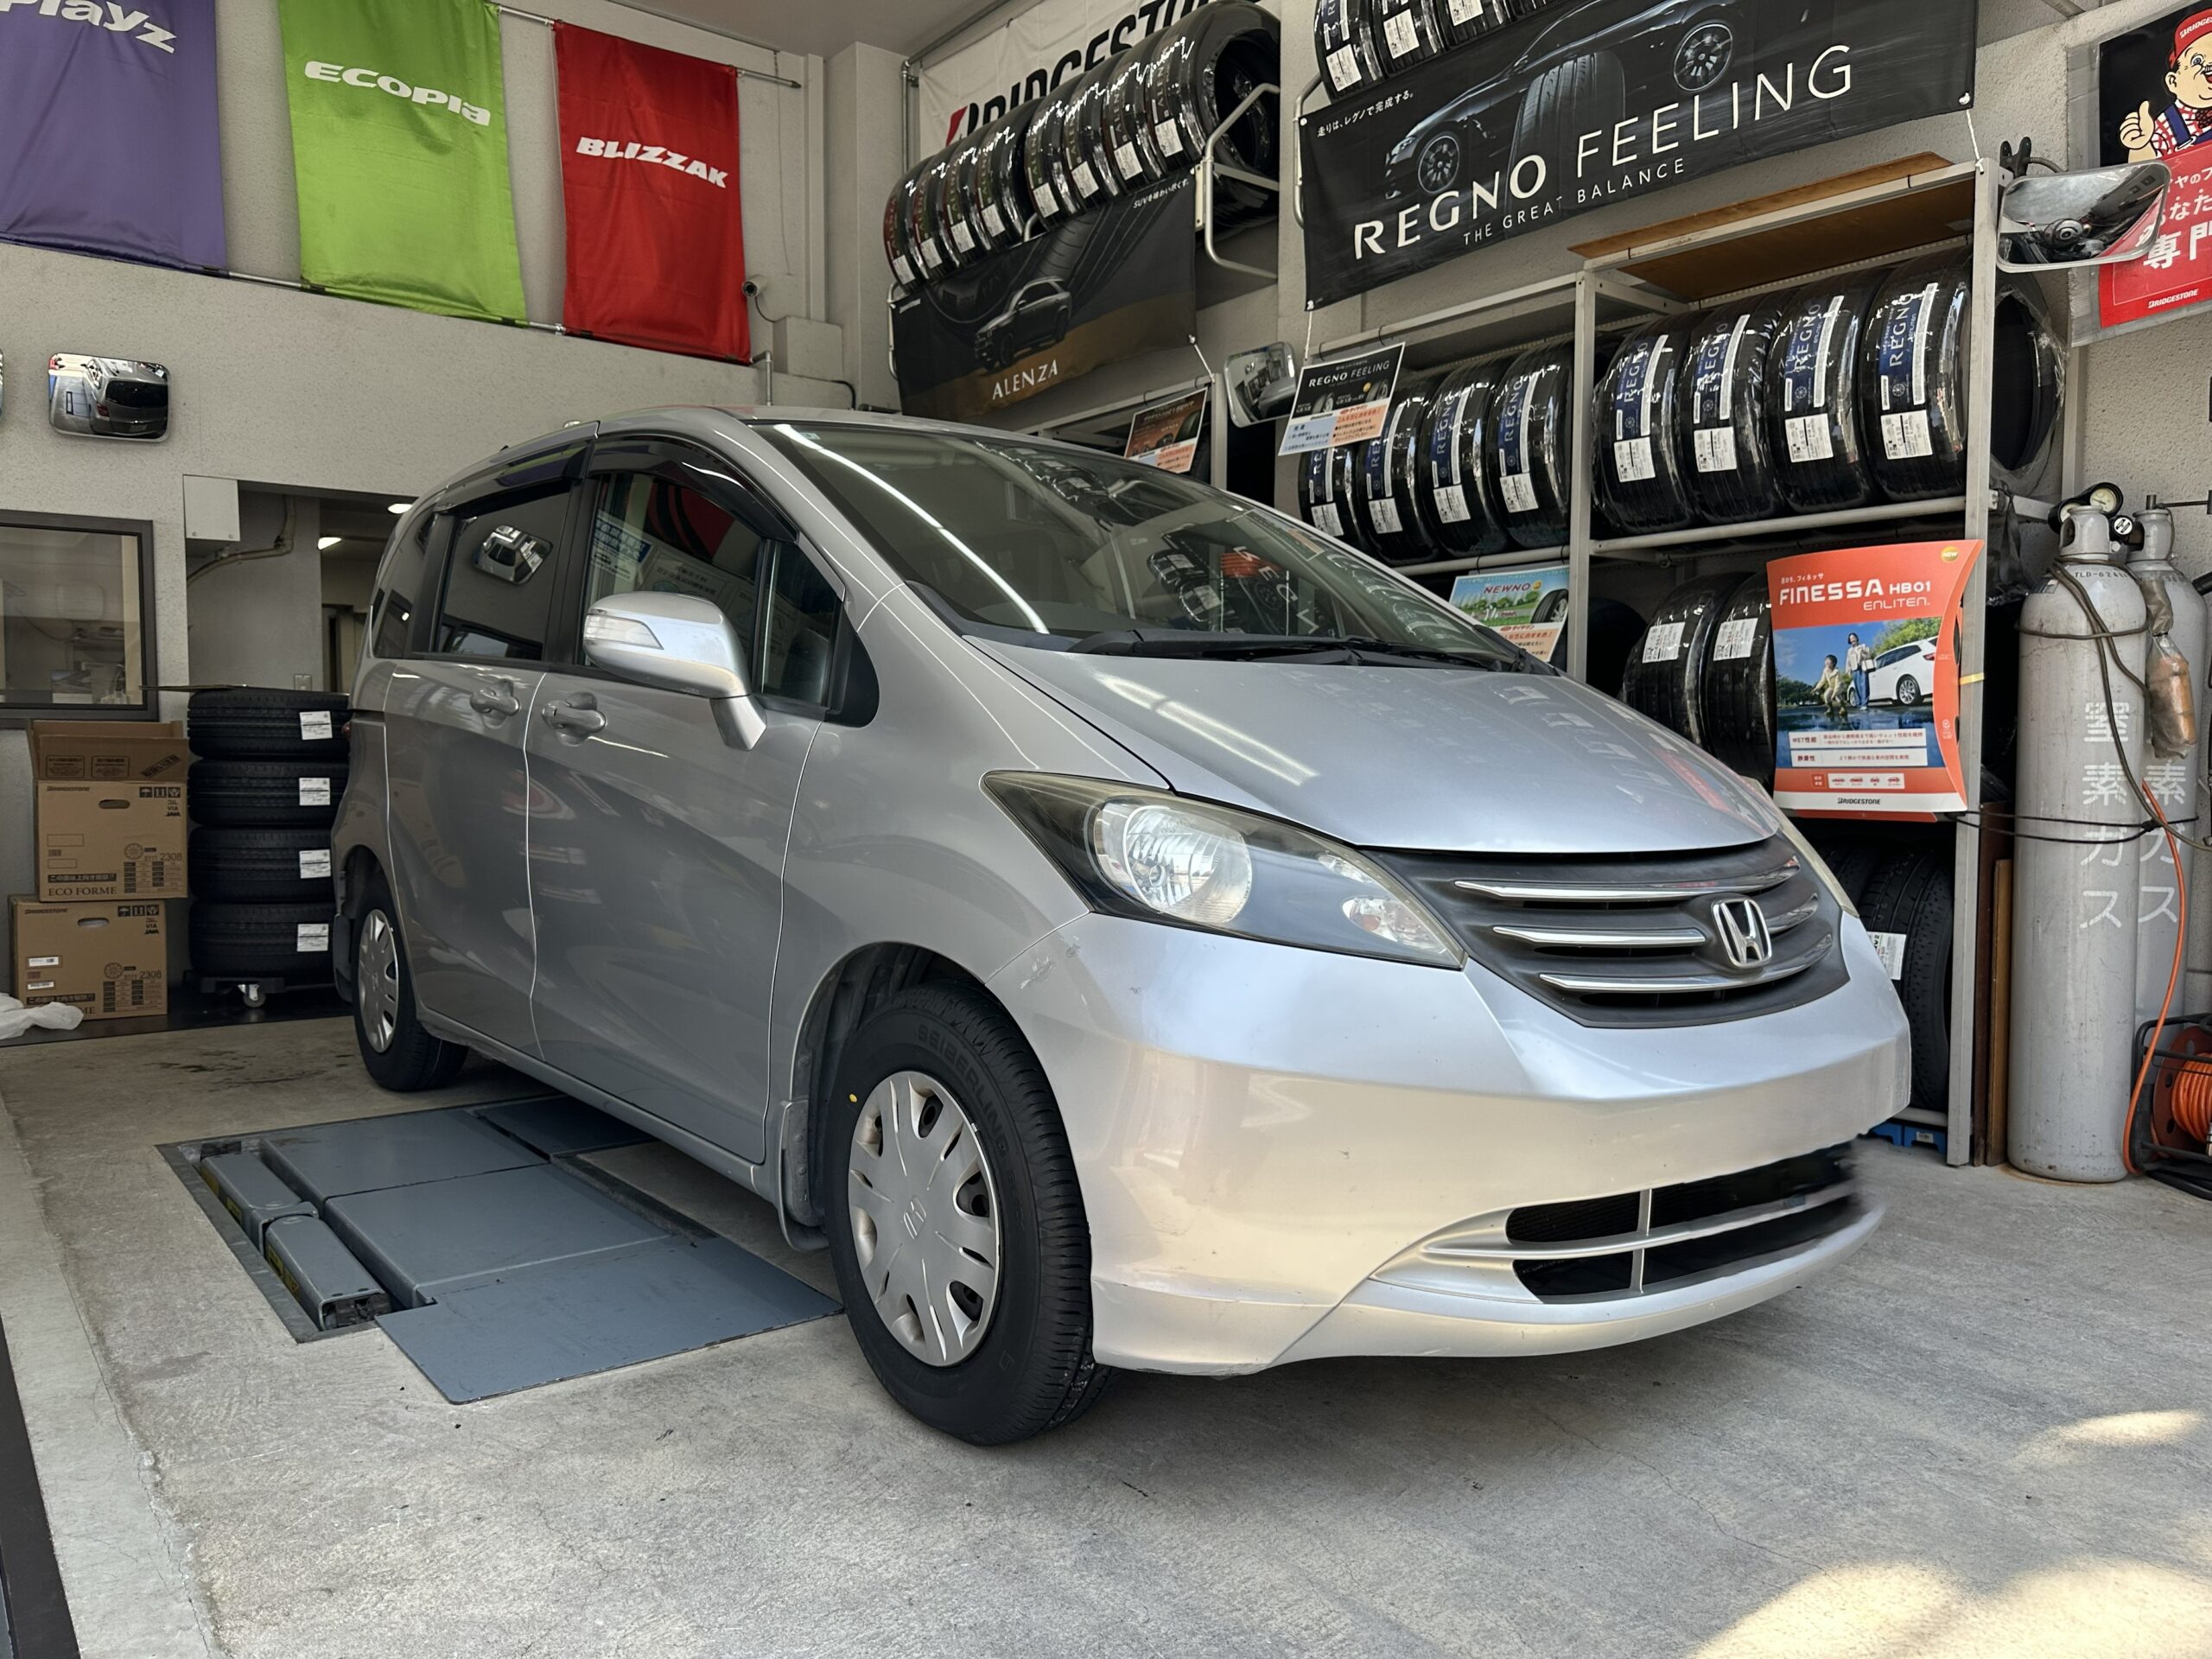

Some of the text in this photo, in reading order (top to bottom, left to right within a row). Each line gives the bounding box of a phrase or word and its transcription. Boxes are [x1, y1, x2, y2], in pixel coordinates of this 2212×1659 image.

[1317, 90, 1414, 137] 走りは、レグノで完成する。
[575, 137, 728, 188] BLIZZAK
[1354, 44, 1851, 260] REGNO FEELING
[1463, 158, 1684, 245] THE GREAT BALANCE
[2147, 289, 2199, 308] BRIDGESTONE
[1795, 304, 1821, 373] REGNO
[1890, 293, 1914, 367] REGNO
[992, 359, 1059, 400] ALENZA
[1308, 372, 1348, 388] REGNO
[1351, 360, 1390, 378] FEELING
[1504, 379, 1523, 442] REGNO
[1484, 583, 1531, 594] NEWNO
[1779, 578, 1884, 606] FINESSA
[1889, 581, 1931, 595] HB01
[1837, 797, 1881, 805] BRIDGESTONE
[160, 853, 182, 861] 2308
[2138, 760, 2187, 924] 素ガス
[48, 886, 118, 896] ECO FORME
[139, 970, 162, 979] 2308
